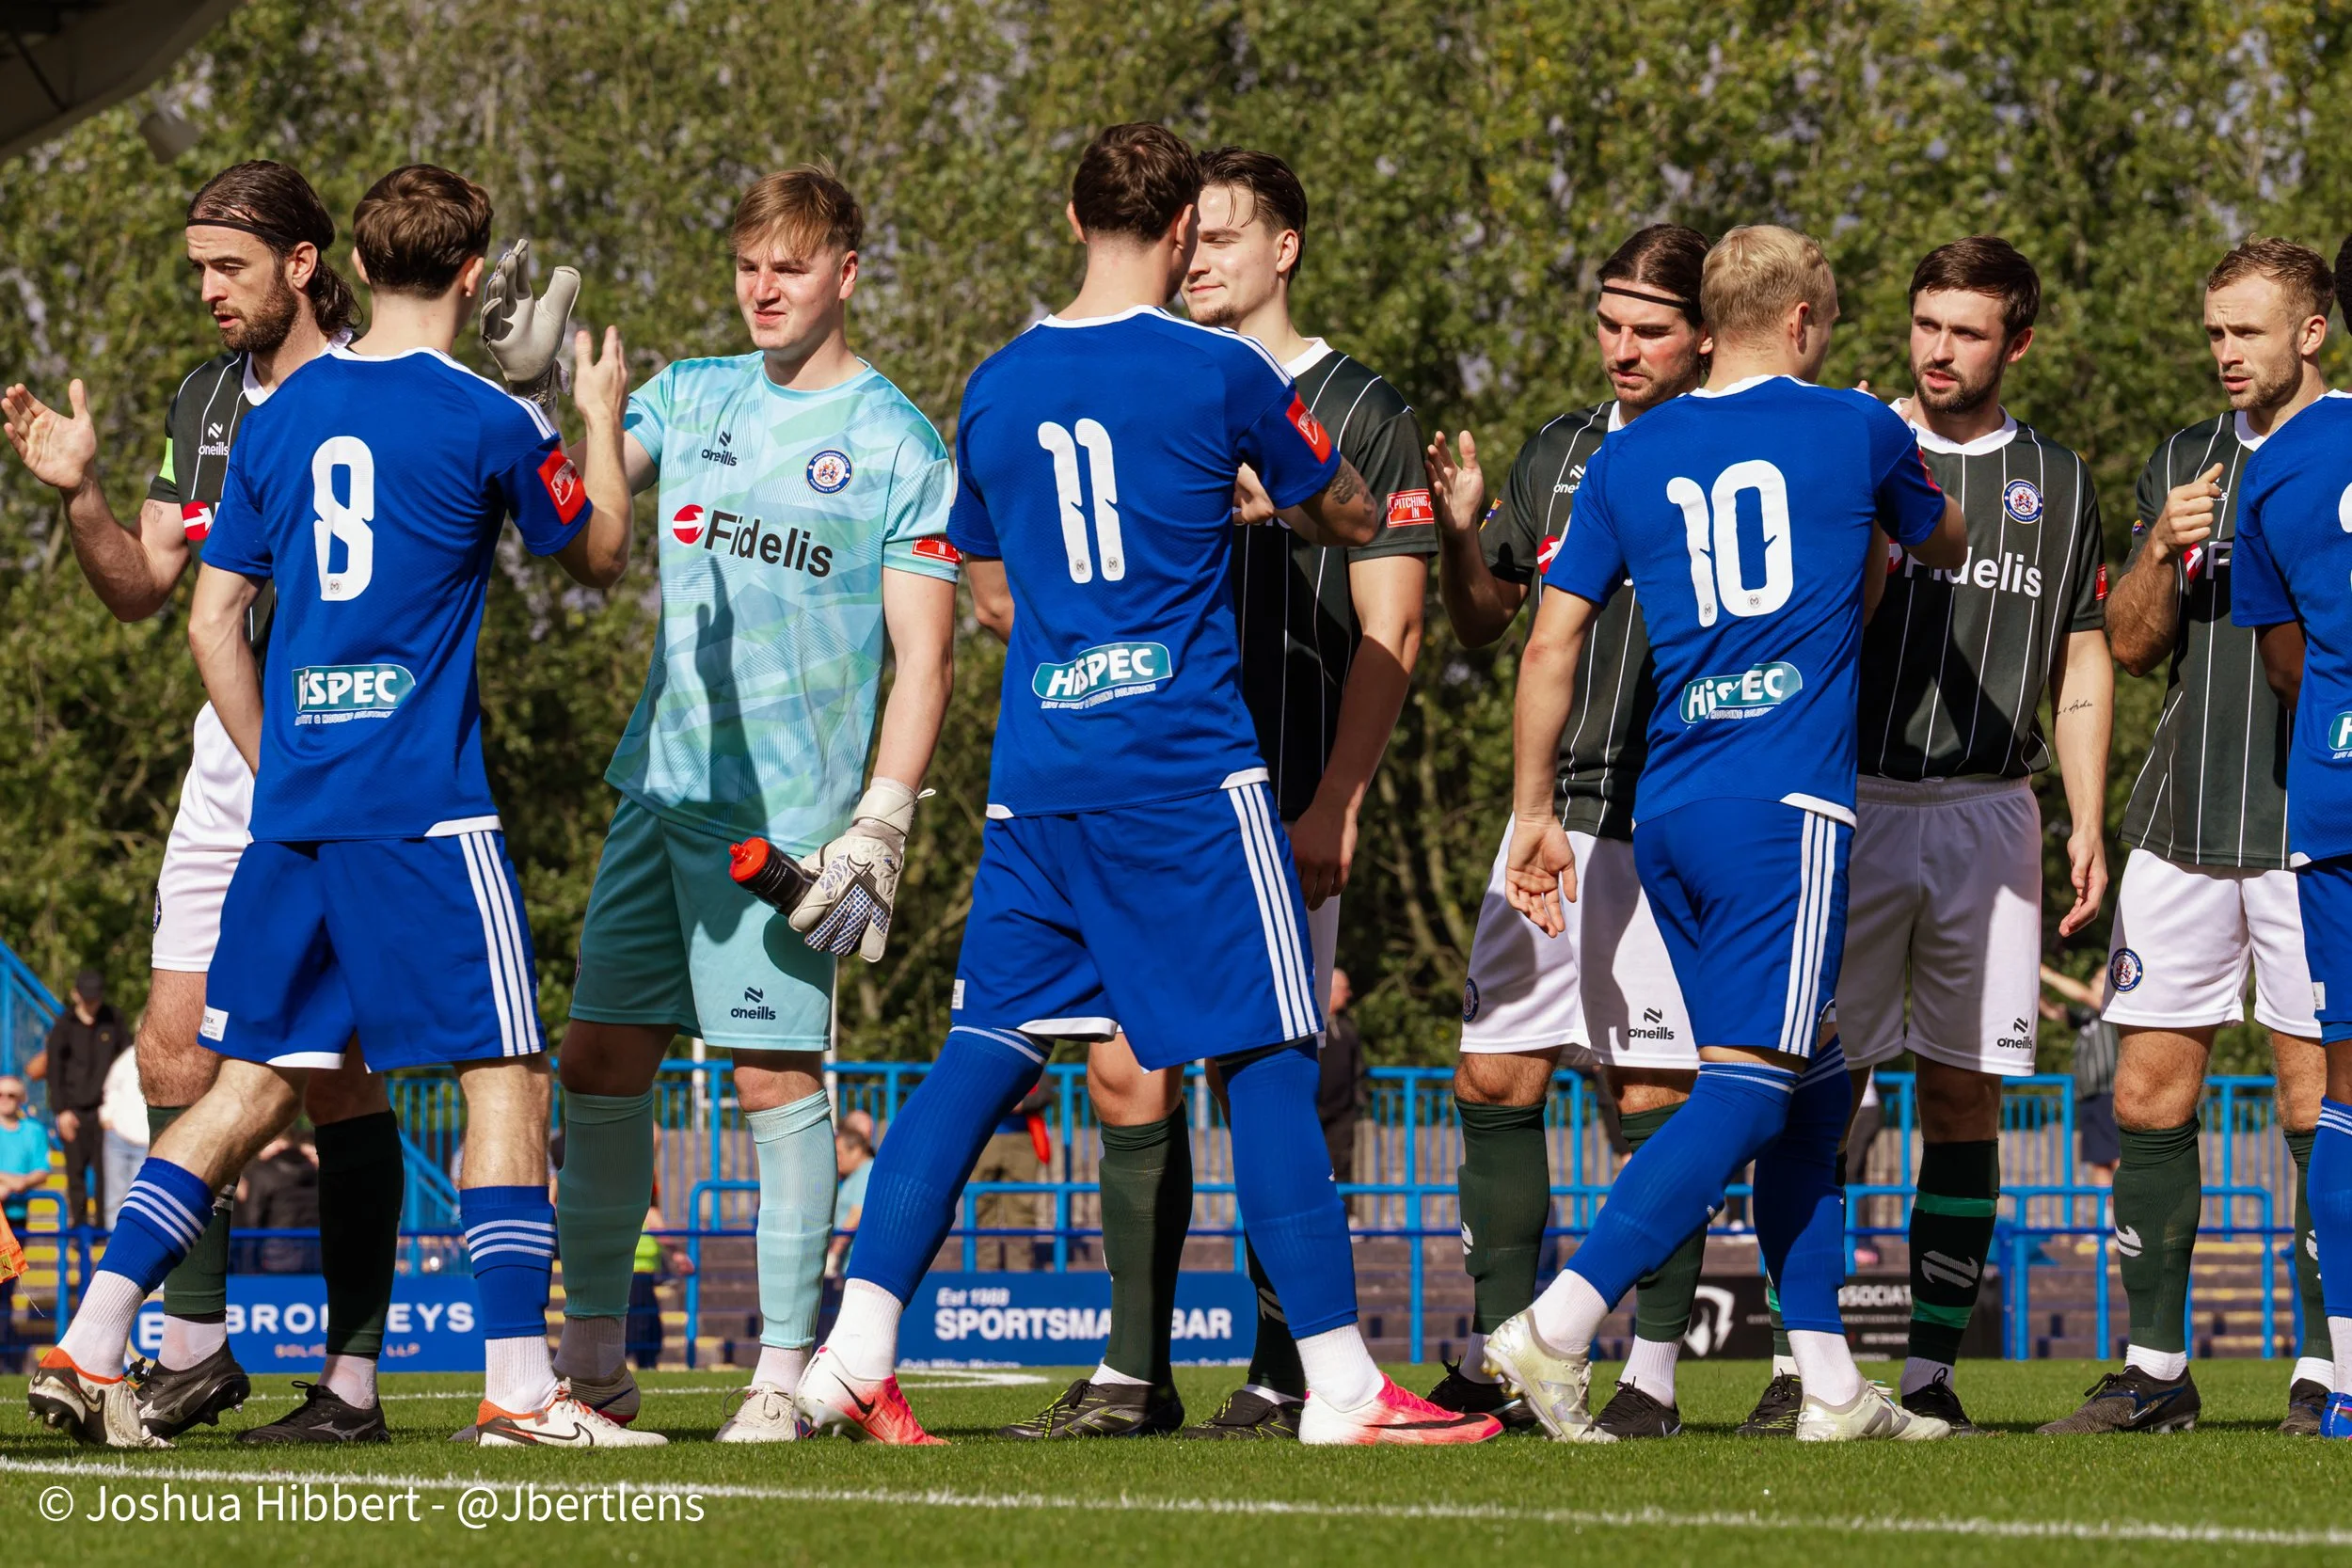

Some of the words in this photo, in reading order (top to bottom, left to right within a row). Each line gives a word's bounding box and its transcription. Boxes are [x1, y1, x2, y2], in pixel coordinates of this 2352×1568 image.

[311, 436, 374, 601] 8
[1038, 418, 1125, 583] 11
[1393, 496, 1428, 509] PITCHING
[1412, 508, 1420, 518] IN
[704, 510, 834, 578] Fidelis
[1666, 459, 1793, 627] 10
[935, 1307, 1111, 1340] SPORTSMA
